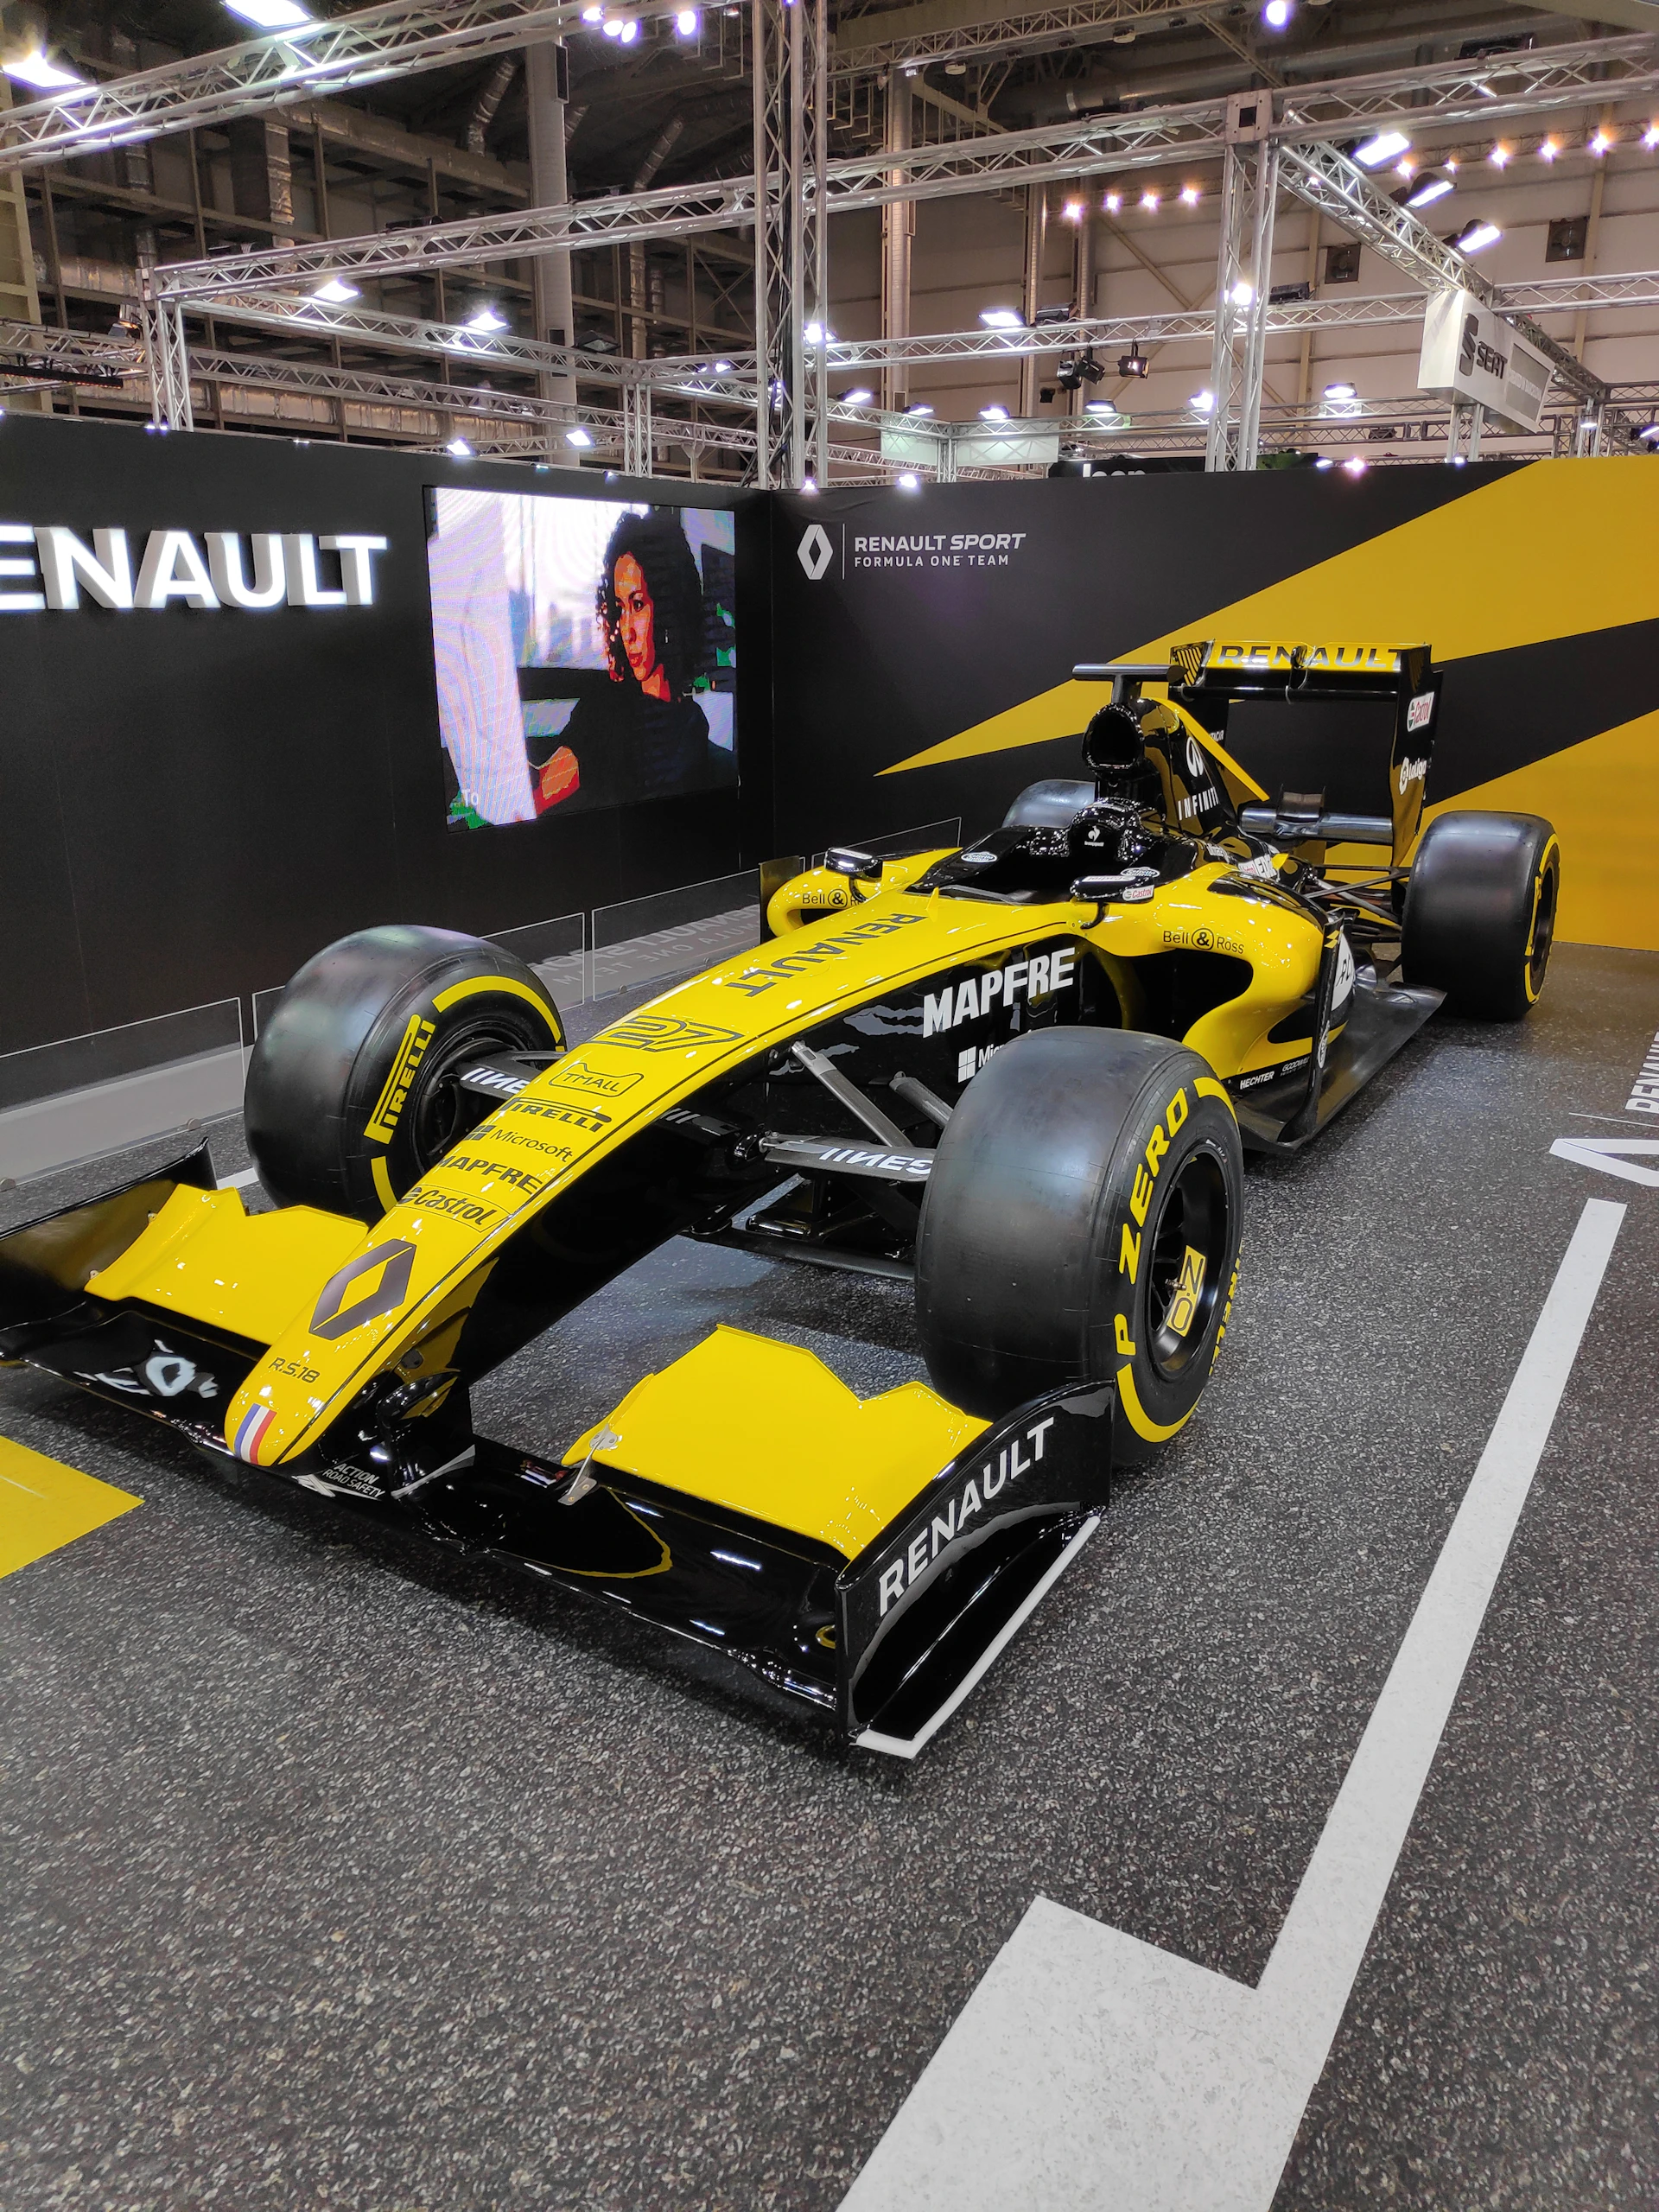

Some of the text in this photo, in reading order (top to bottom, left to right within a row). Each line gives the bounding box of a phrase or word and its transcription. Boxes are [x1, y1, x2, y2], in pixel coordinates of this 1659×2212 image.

[1477, 341, 1508, 379] SEAT
[854, 532, 1027, 552] RENAULT SPORT
[0, 524, 388, 610] ENAULT
[854, 556, 924, 568] FORMULA
[968, 555, 1009, 566] TEAM
[802, 893, 825, 905] Bell
[1132, 887, 1152, 899] Castrol
[724, 912, 928, 998] RENAULT
[1163, 931, 1189, 944] Bell
[1217, 937, 1245, 955] Ross
[923, 946, 1076, 1039] MAPFRE
[588, 1014, 745, 1053] 27
[363, 1014, 436, 1145] PIRELLI
[1239, 1071, 1275, 1090] HECHTER
[498, 1096, 613, 1133] PIRELLI
[489, 1129, 574, 1162] Microsoft
[413, 1188, 498, 1226] Castrol
[1114, 1087, 1190, 1356] P ZERO
[268, 1357, 321, 1383] R.S.18
[322, 1469, 386, 1498] ROAD SAFETY
[334, 1463, 380, 1485] ACTION
[878, 1416, 1055, 1618] RENAULT
